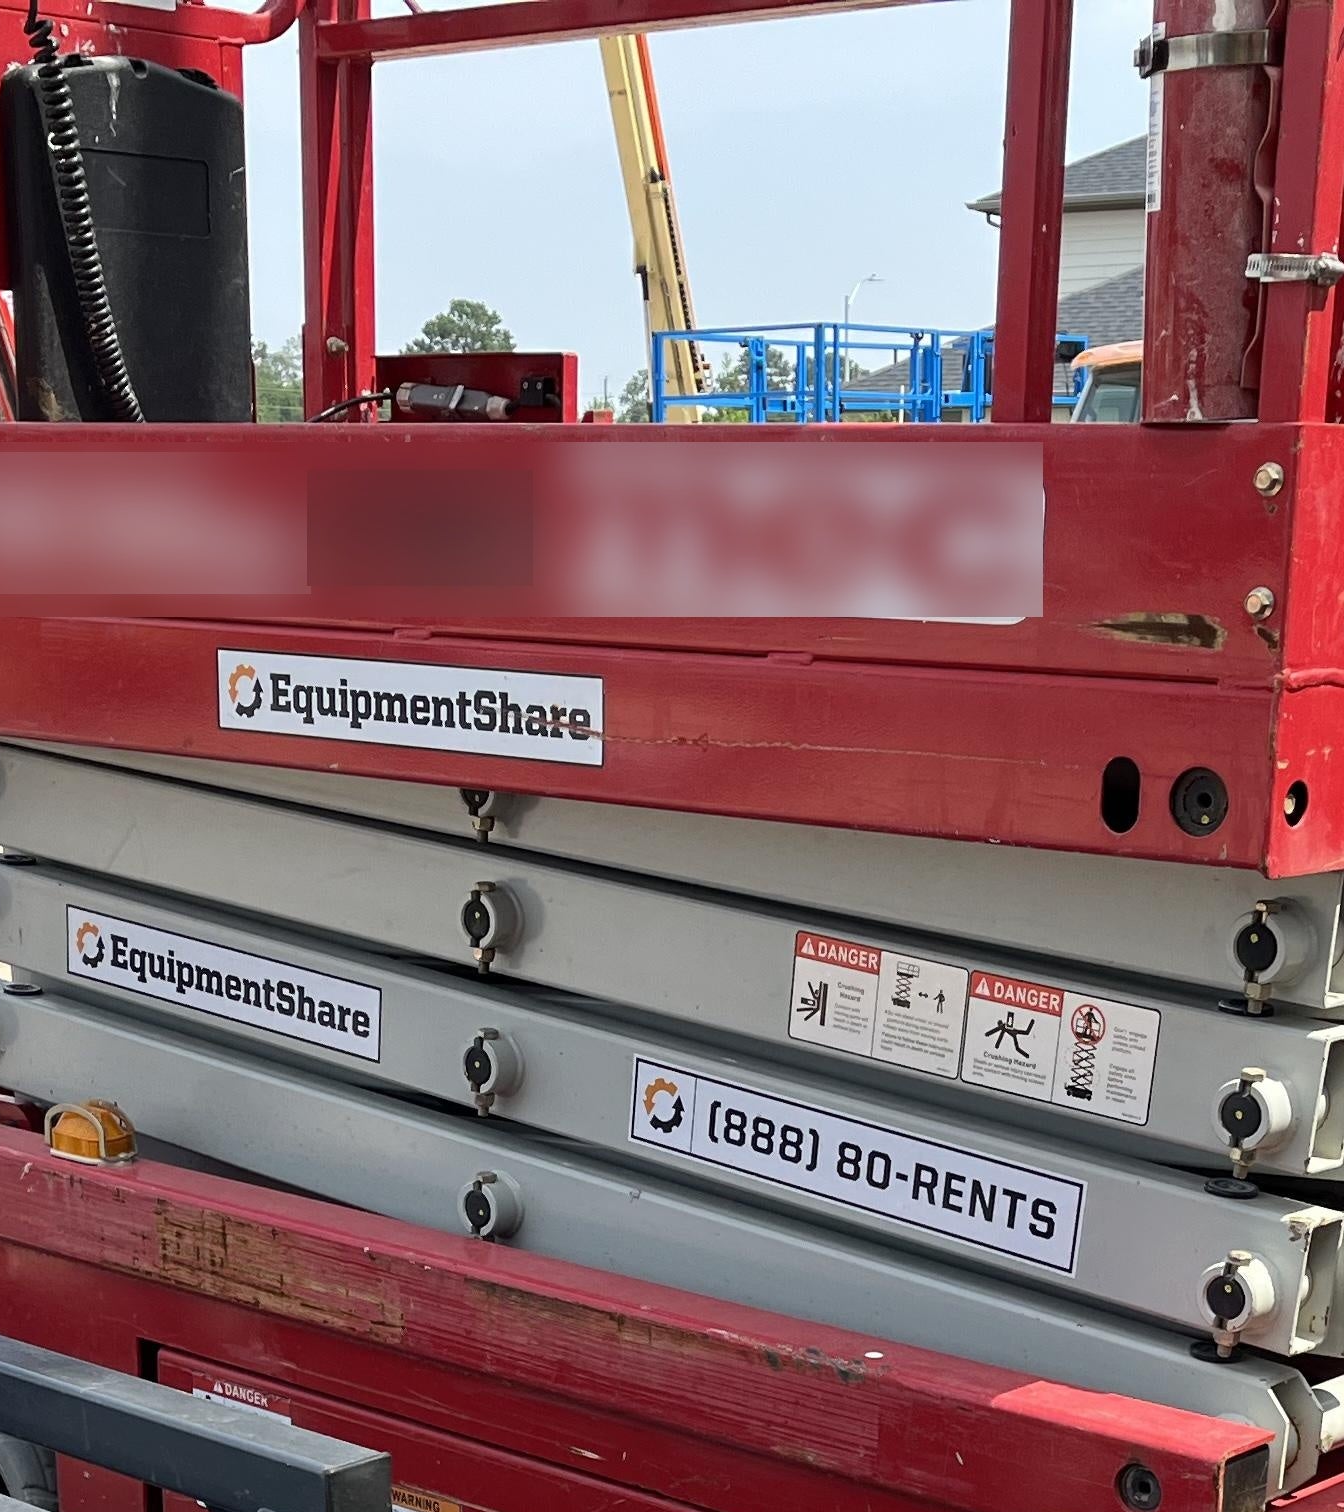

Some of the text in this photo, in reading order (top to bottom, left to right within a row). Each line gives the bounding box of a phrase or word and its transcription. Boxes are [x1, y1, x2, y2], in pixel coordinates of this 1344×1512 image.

[269, 672, 591, 740] EquipmentShare
[818, 940, 878, 970] DANGER
[109, 935, 371, 1039] EquipmentShare
[993, 982, 1061, 1012] DANGER
[708, 1101, 1059, 1242] (888) 80-RENTS
[223, 1381, 270, 1408] DANGER
